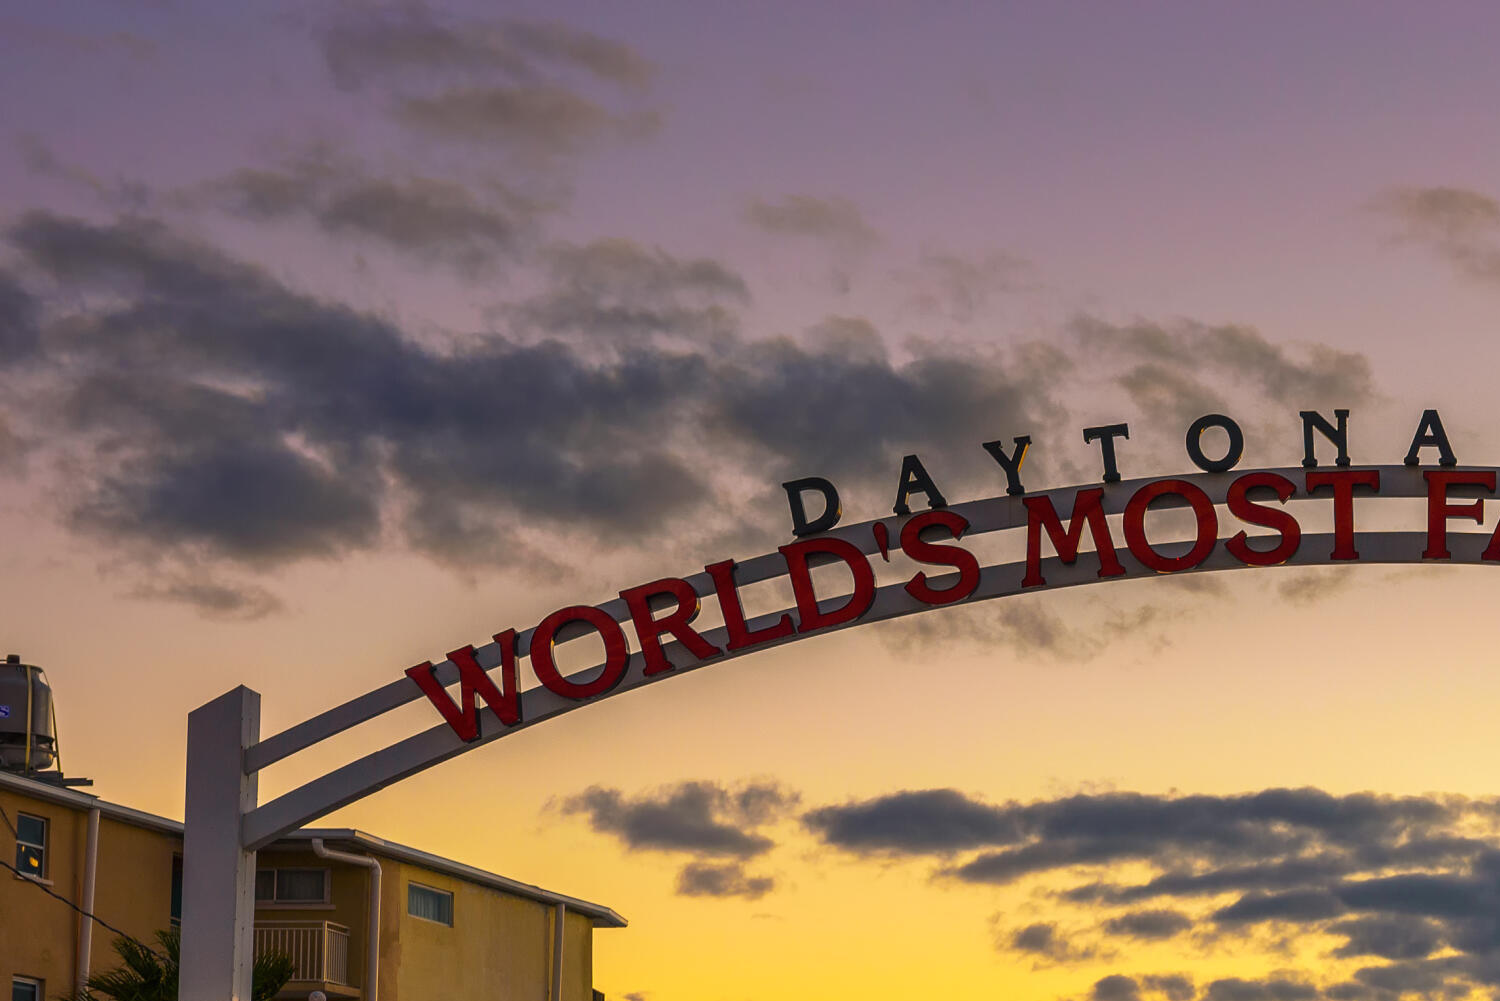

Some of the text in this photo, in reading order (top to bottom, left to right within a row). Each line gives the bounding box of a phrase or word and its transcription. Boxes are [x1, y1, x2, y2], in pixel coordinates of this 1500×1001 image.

[782, 409, 1457, 537] DAYTONA
[405, 512, 982, 743] WORLD'S
[1021, 470, 1381, 589] MOST
